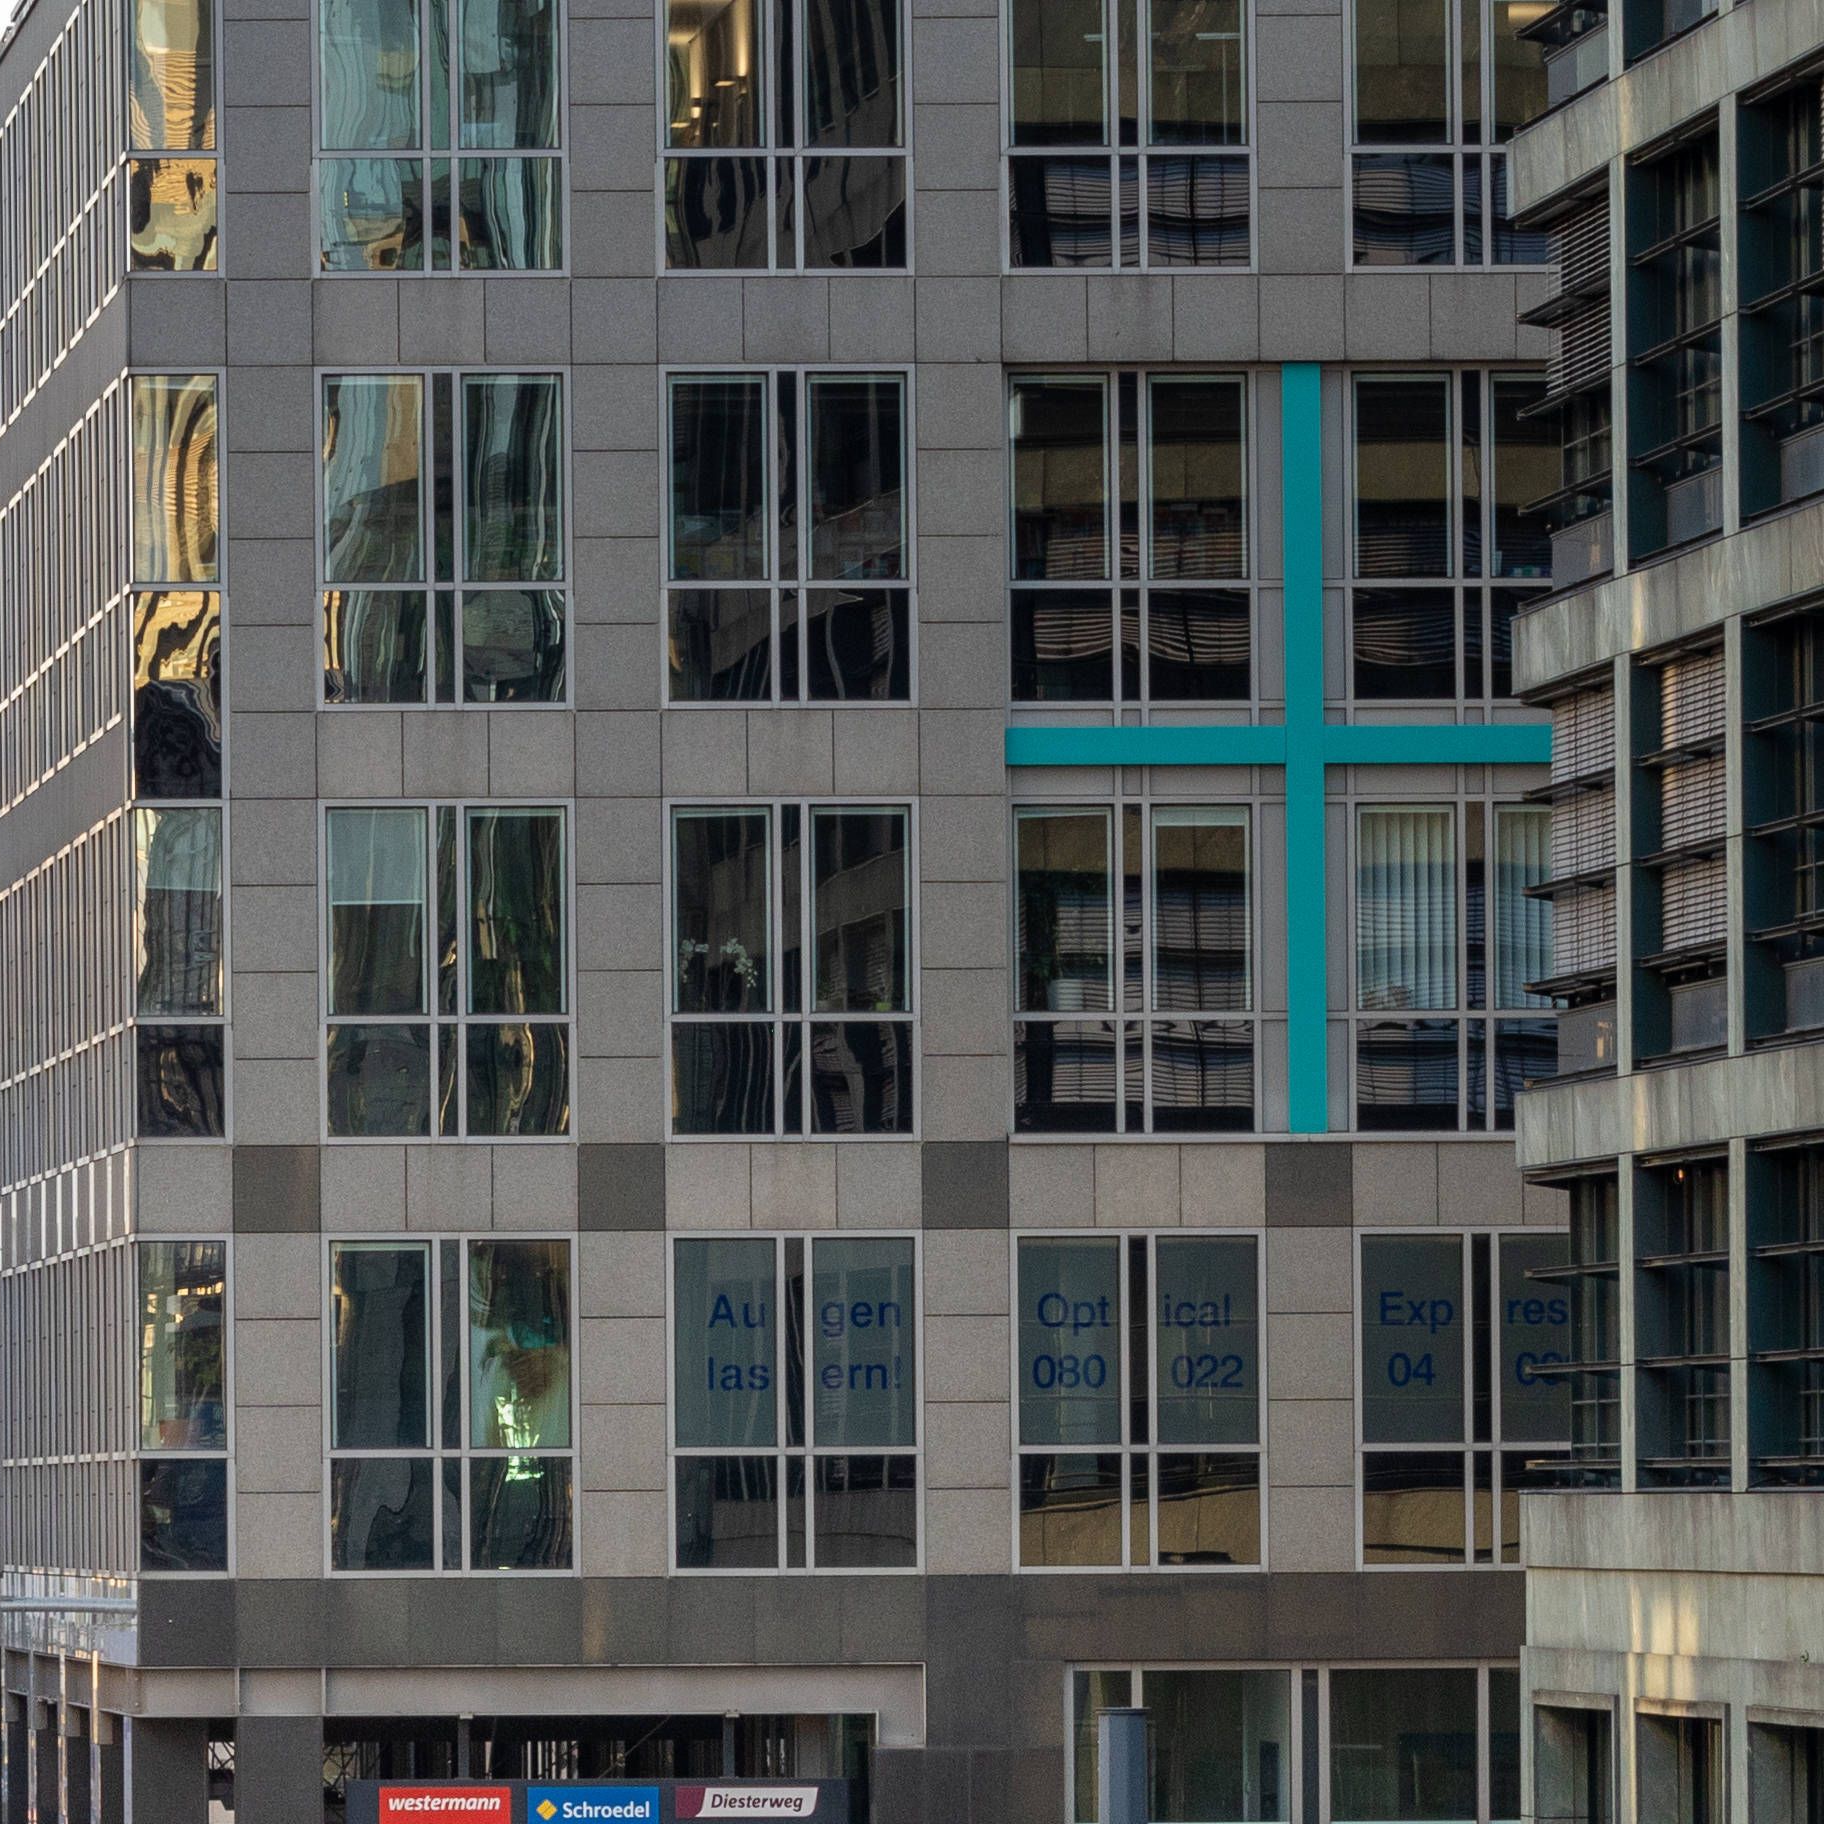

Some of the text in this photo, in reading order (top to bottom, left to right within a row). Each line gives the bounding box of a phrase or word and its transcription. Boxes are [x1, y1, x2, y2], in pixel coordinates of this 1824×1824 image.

[388, 1794, 501, 1811] westermann
[562, 1801, 650, 1819] Schroedel
[710, 1793, 804, 1812] Diesterweg
